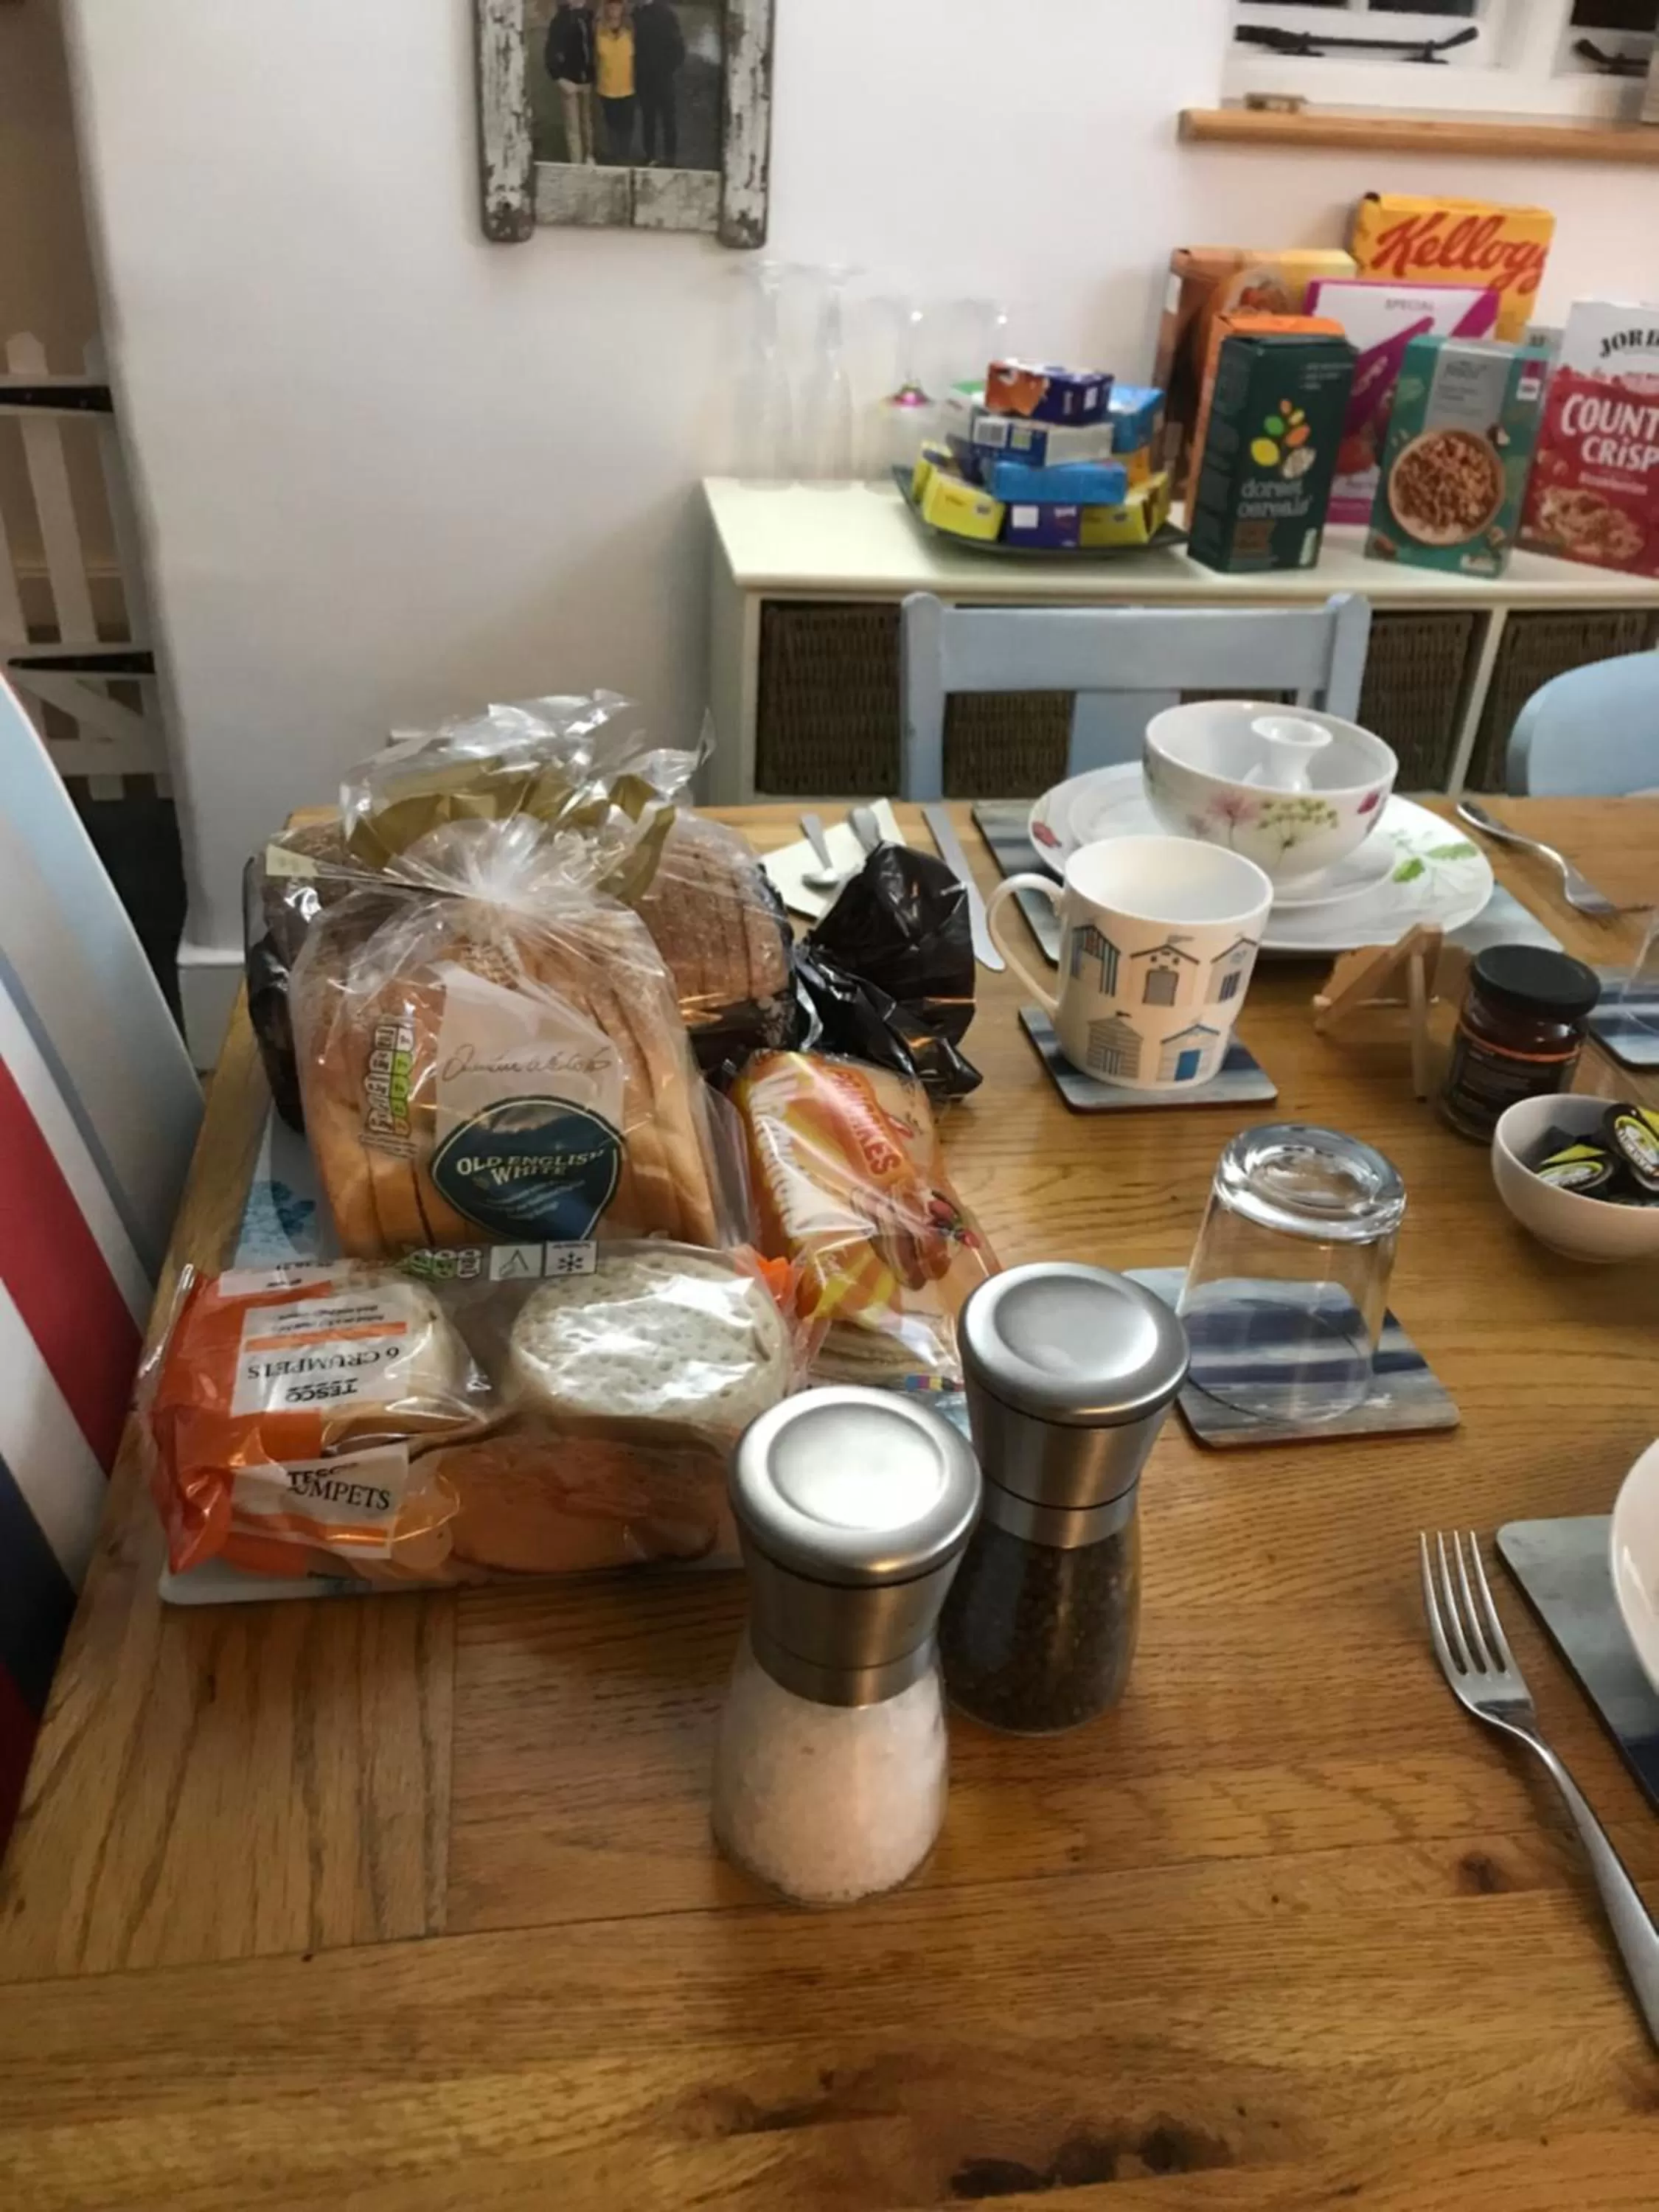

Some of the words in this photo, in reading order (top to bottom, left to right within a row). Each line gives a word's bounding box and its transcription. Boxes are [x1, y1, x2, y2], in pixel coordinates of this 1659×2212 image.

[456, 1155, 503, 1176] OLD
[490, 1166, 567, 1186] WHITE
[386, 1346, 400, 1359] 6
[247, 1350, 380, 1380] CRUMPETS
[285, 1381, 358, 1403] TESCO
